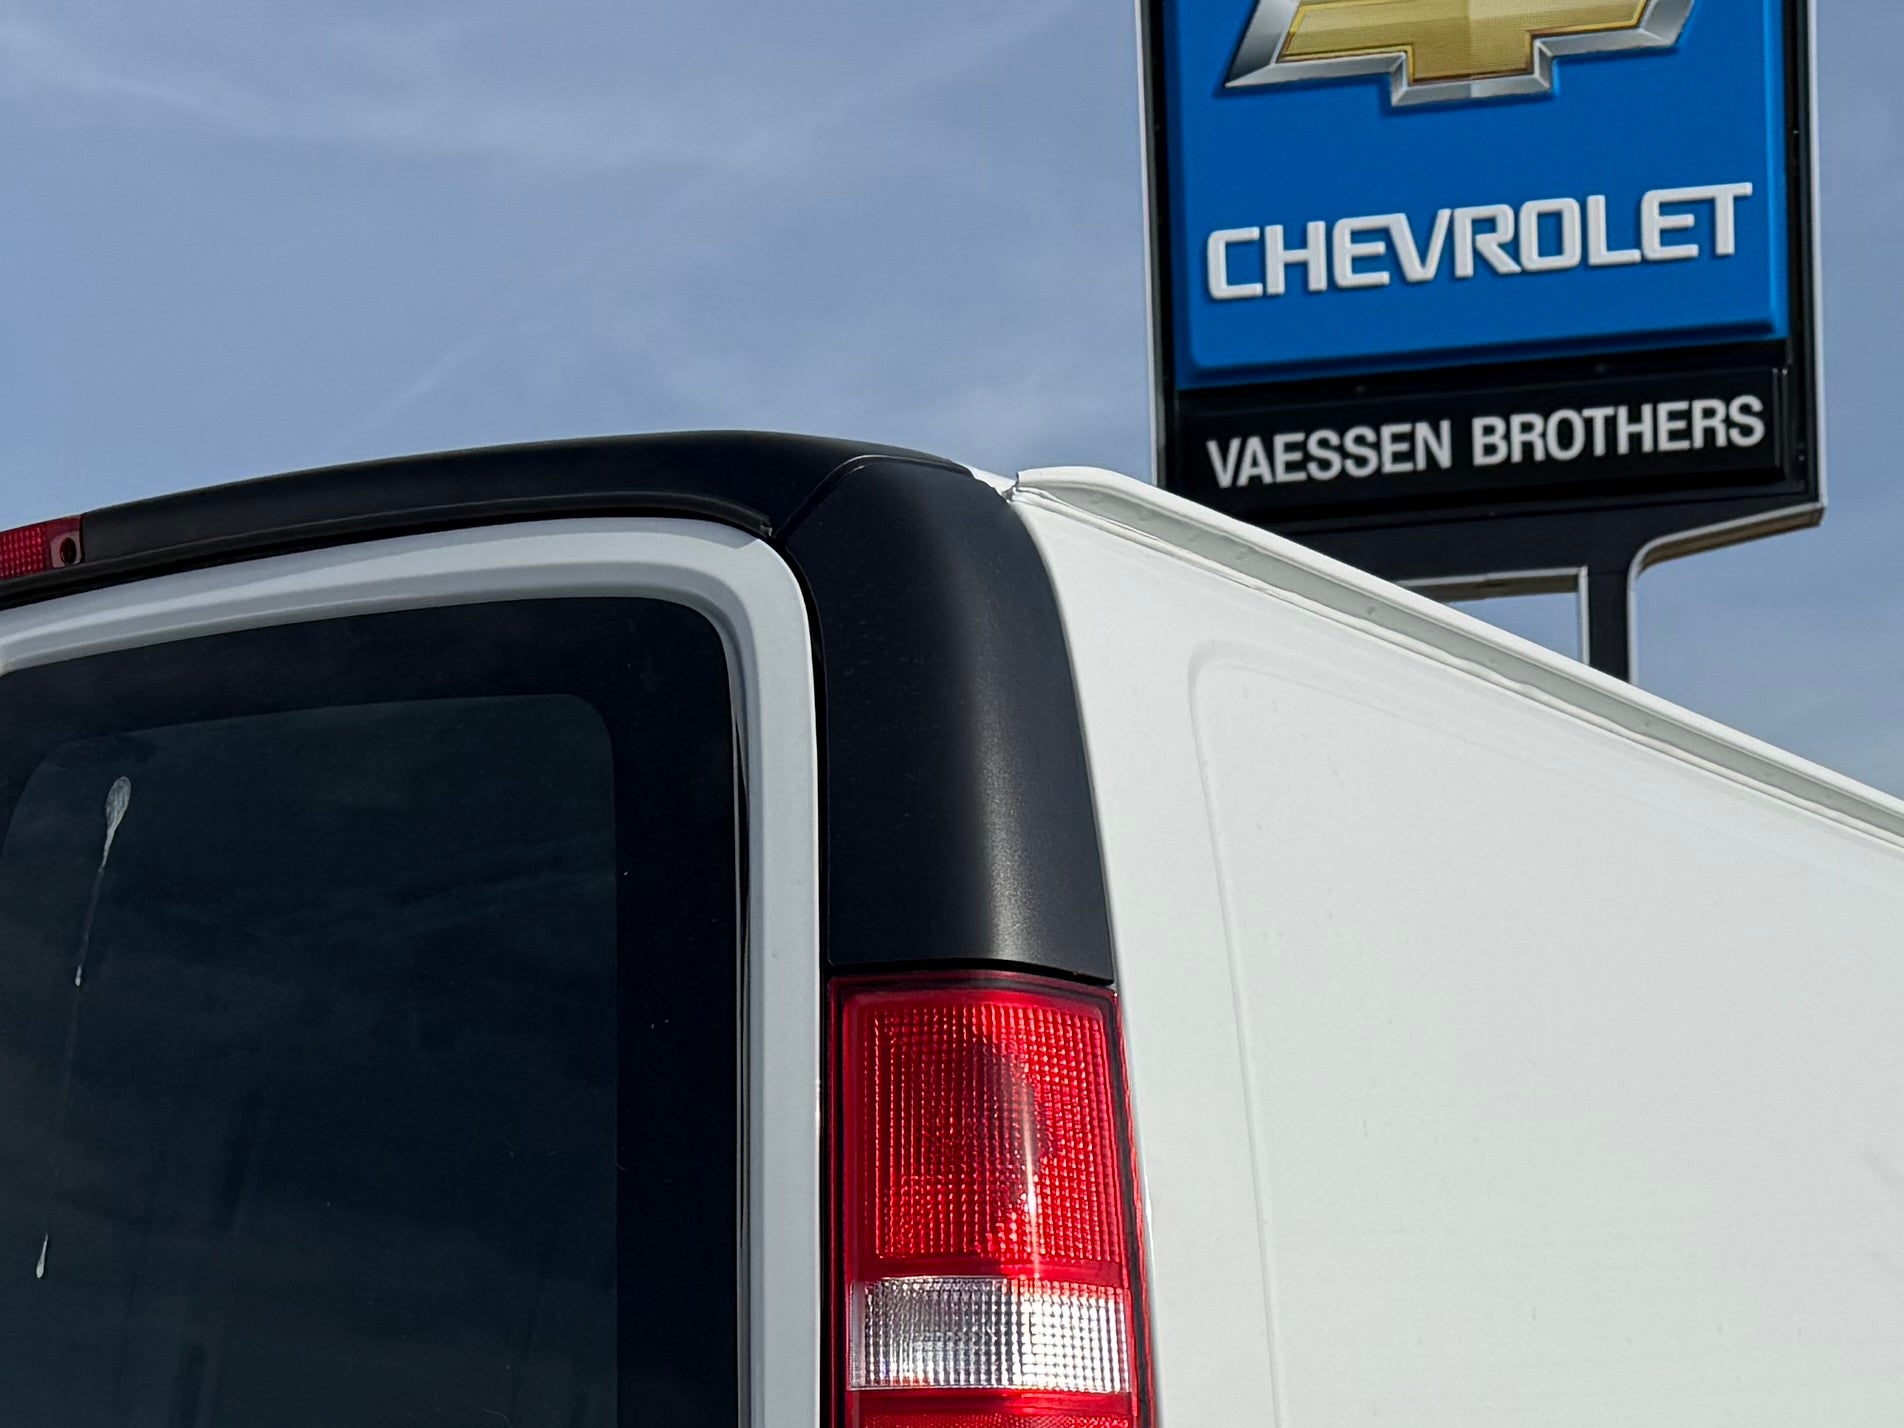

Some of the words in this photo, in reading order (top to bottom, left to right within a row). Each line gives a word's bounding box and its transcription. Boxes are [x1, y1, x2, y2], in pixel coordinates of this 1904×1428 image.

[1207, 182, 1753, 300] CHEVROLET
[1207, 420, 1452, 489] VAESSEN
[1472, 395, 1766, 467] BROTHERS
